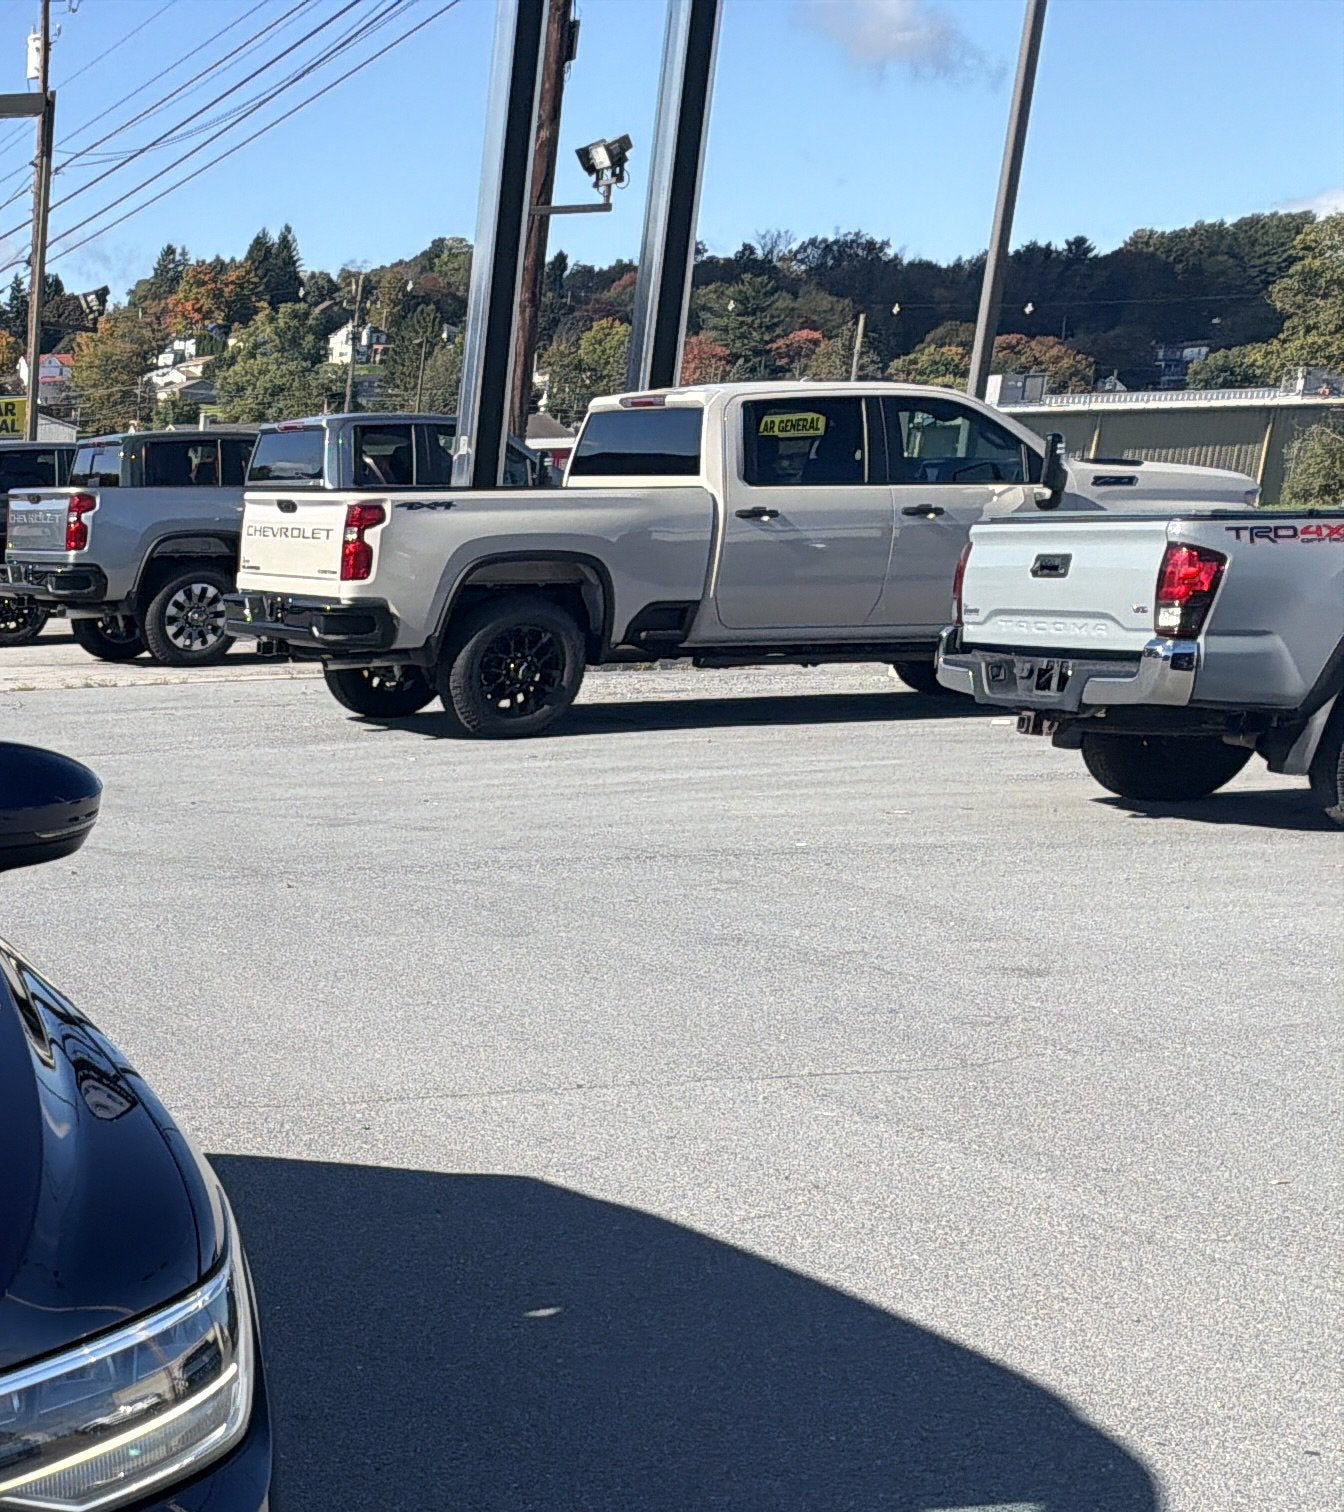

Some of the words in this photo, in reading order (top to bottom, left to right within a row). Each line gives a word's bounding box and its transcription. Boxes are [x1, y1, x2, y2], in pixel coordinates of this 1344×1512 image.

[761, 419, 775, 433] AR
[778, 416, 820, 432] GENERAL
[246, 525, 334, 540] CHEVROLET
[1225, 526, 1299, 543] TRD
[998, 619, 1109, 636] TACOMA
